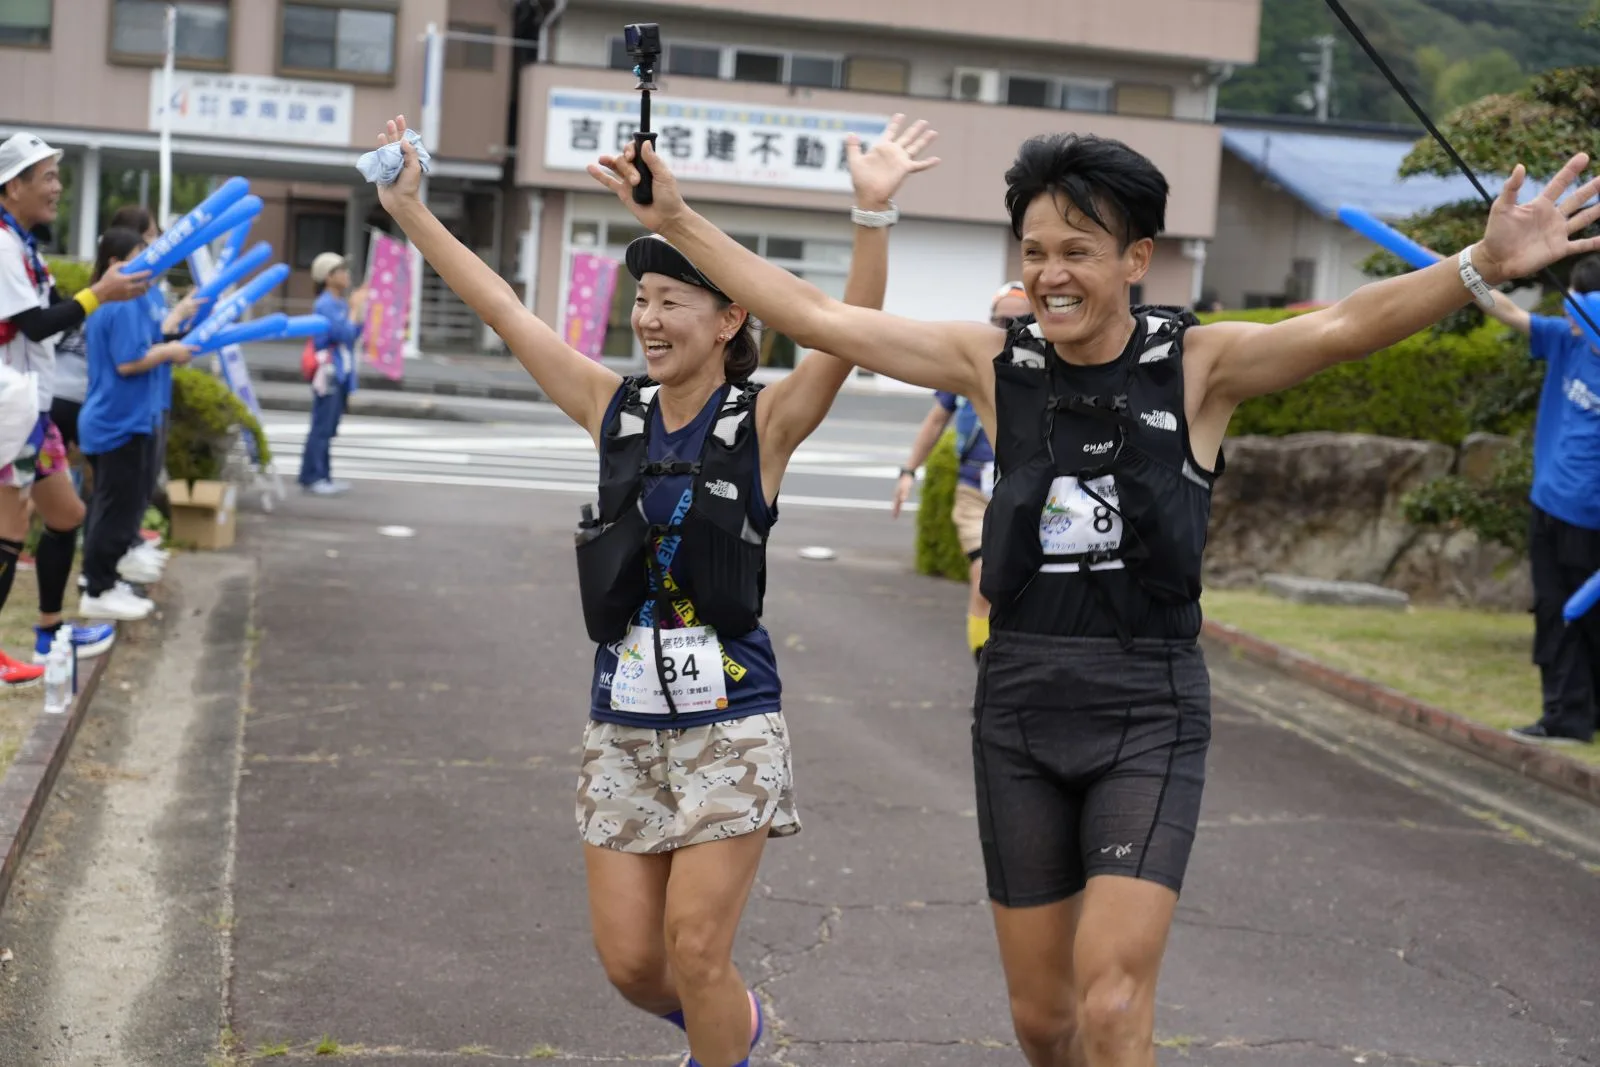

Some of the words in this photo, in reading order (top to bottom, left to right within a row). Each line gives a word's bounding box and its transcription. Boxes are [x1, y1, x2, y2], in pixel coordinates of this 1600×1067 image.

[1082, 440, 1114, 453] CHAOS
[661, 635, 709, 650] 高砂熱学
[662, 653, 700, 685] 84
